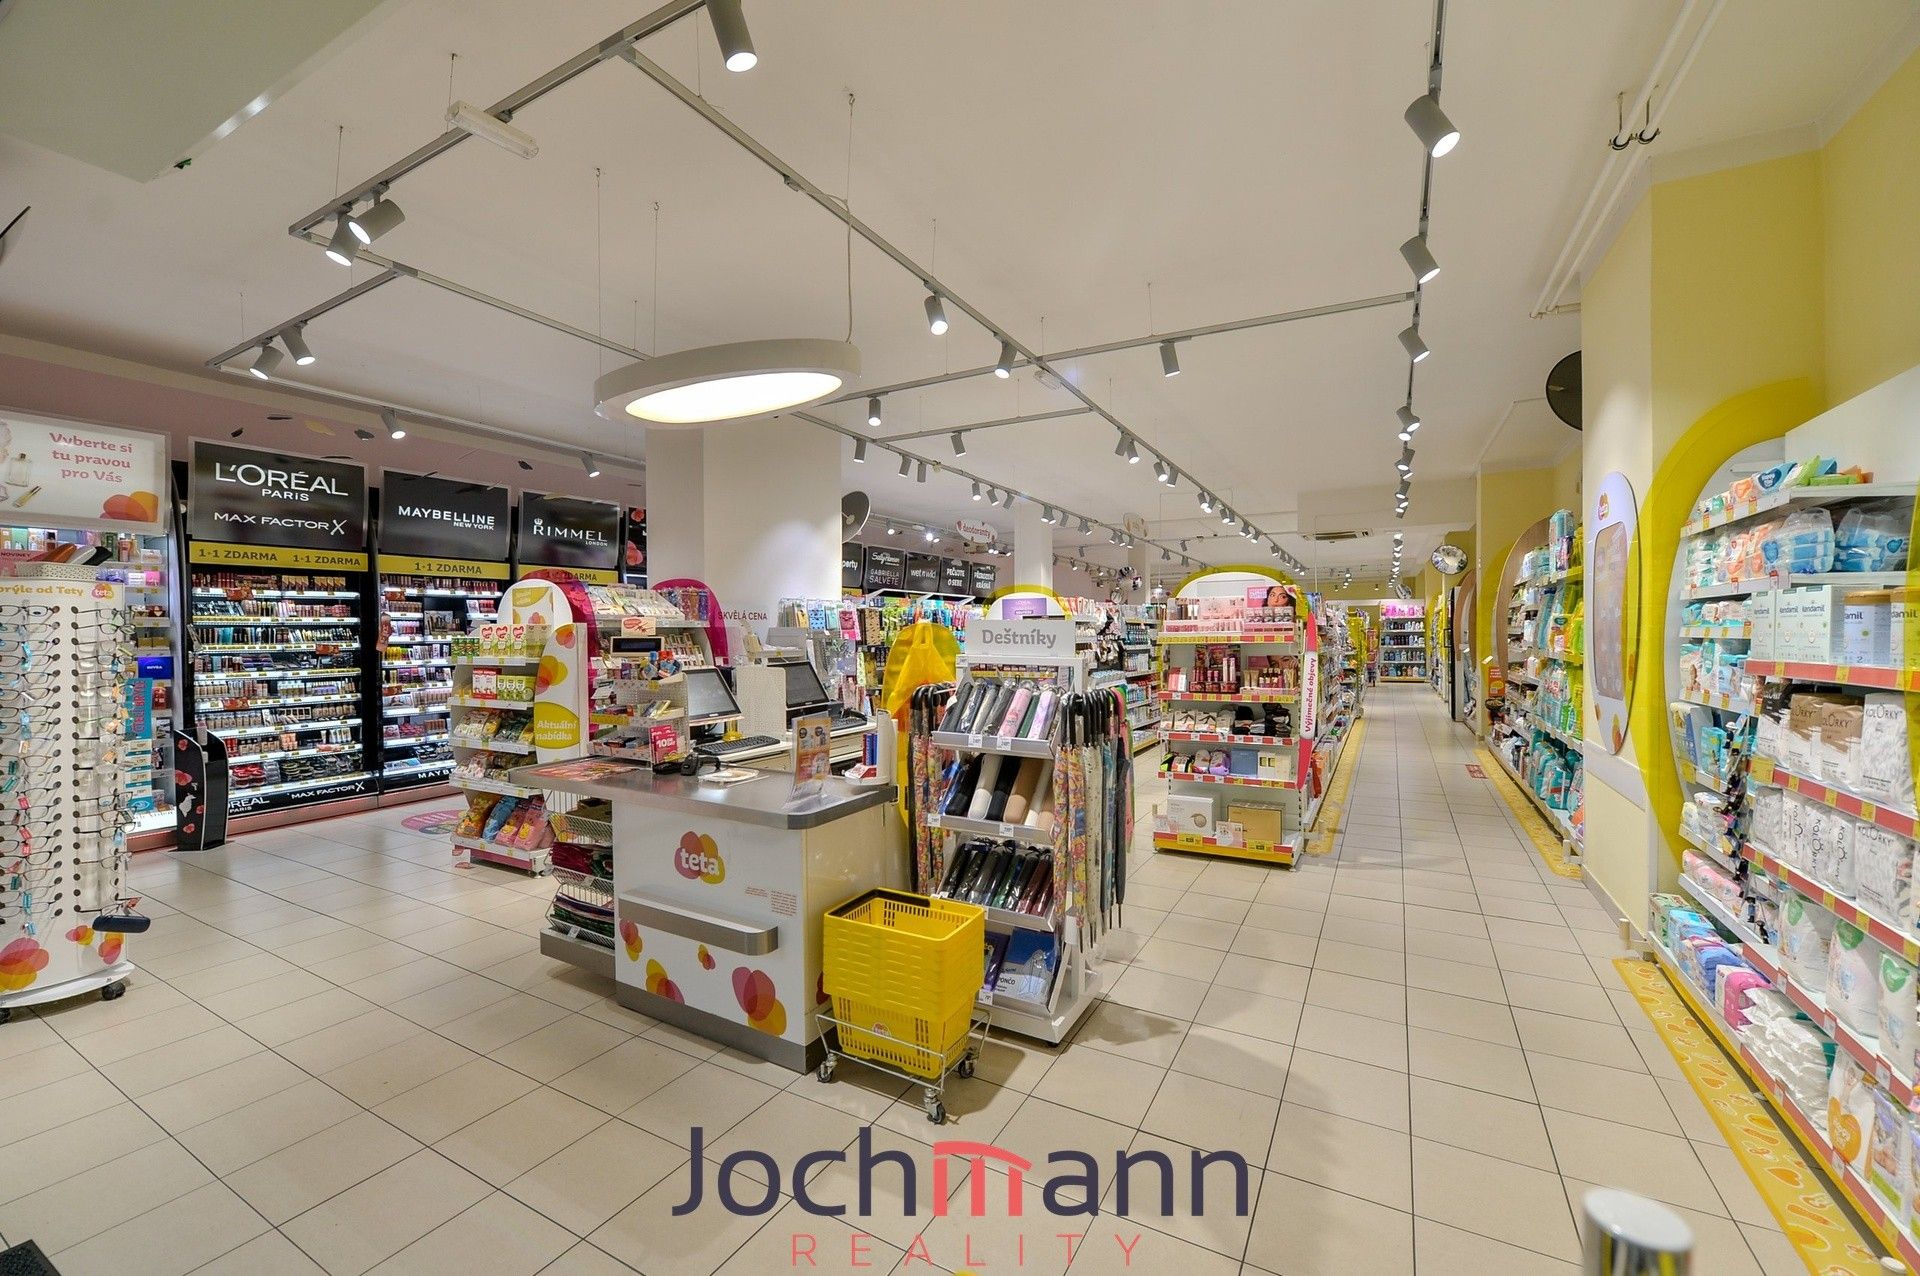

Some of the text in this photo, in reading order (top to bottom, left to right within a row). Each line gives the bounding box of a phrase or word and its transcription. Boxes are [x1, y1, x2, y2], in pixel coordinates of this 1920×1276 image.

[120, 443, 133, 453] si
[52, 450, 131, 469] tu pravou
[61, 468, 123, 483] pro Vás
[261, 488, 310, 502] PARIS
[214, 512, 257, 525] MAX
[398, 505, 496, 526] MAYBELLINE
[453, 521, 494, 531] NEW YORK
[533, 523, 608, 543] RIMMEL
[224, 550, 278, 562] ZDARMA
[314, 555, 361, 566] ZDARMA
[436, 562, 482, 574] ZDARMA
[869, 575, 899, 585] SALVETE
[36, 585, 53, 594] od
[56, 586, 84, 597] Tety
[717, 609, 768, 621] SKVĚLÁ CENA
[981, 628, 1057, 649] Deštníky
[1308, 657, 1317, 686] objevy
[536, 730, 573, 740] nabídka
[291, 791, 315, 799] MAX
[230, 806, 253, 814] PARIS
[680, 848, 720, 876] teta
